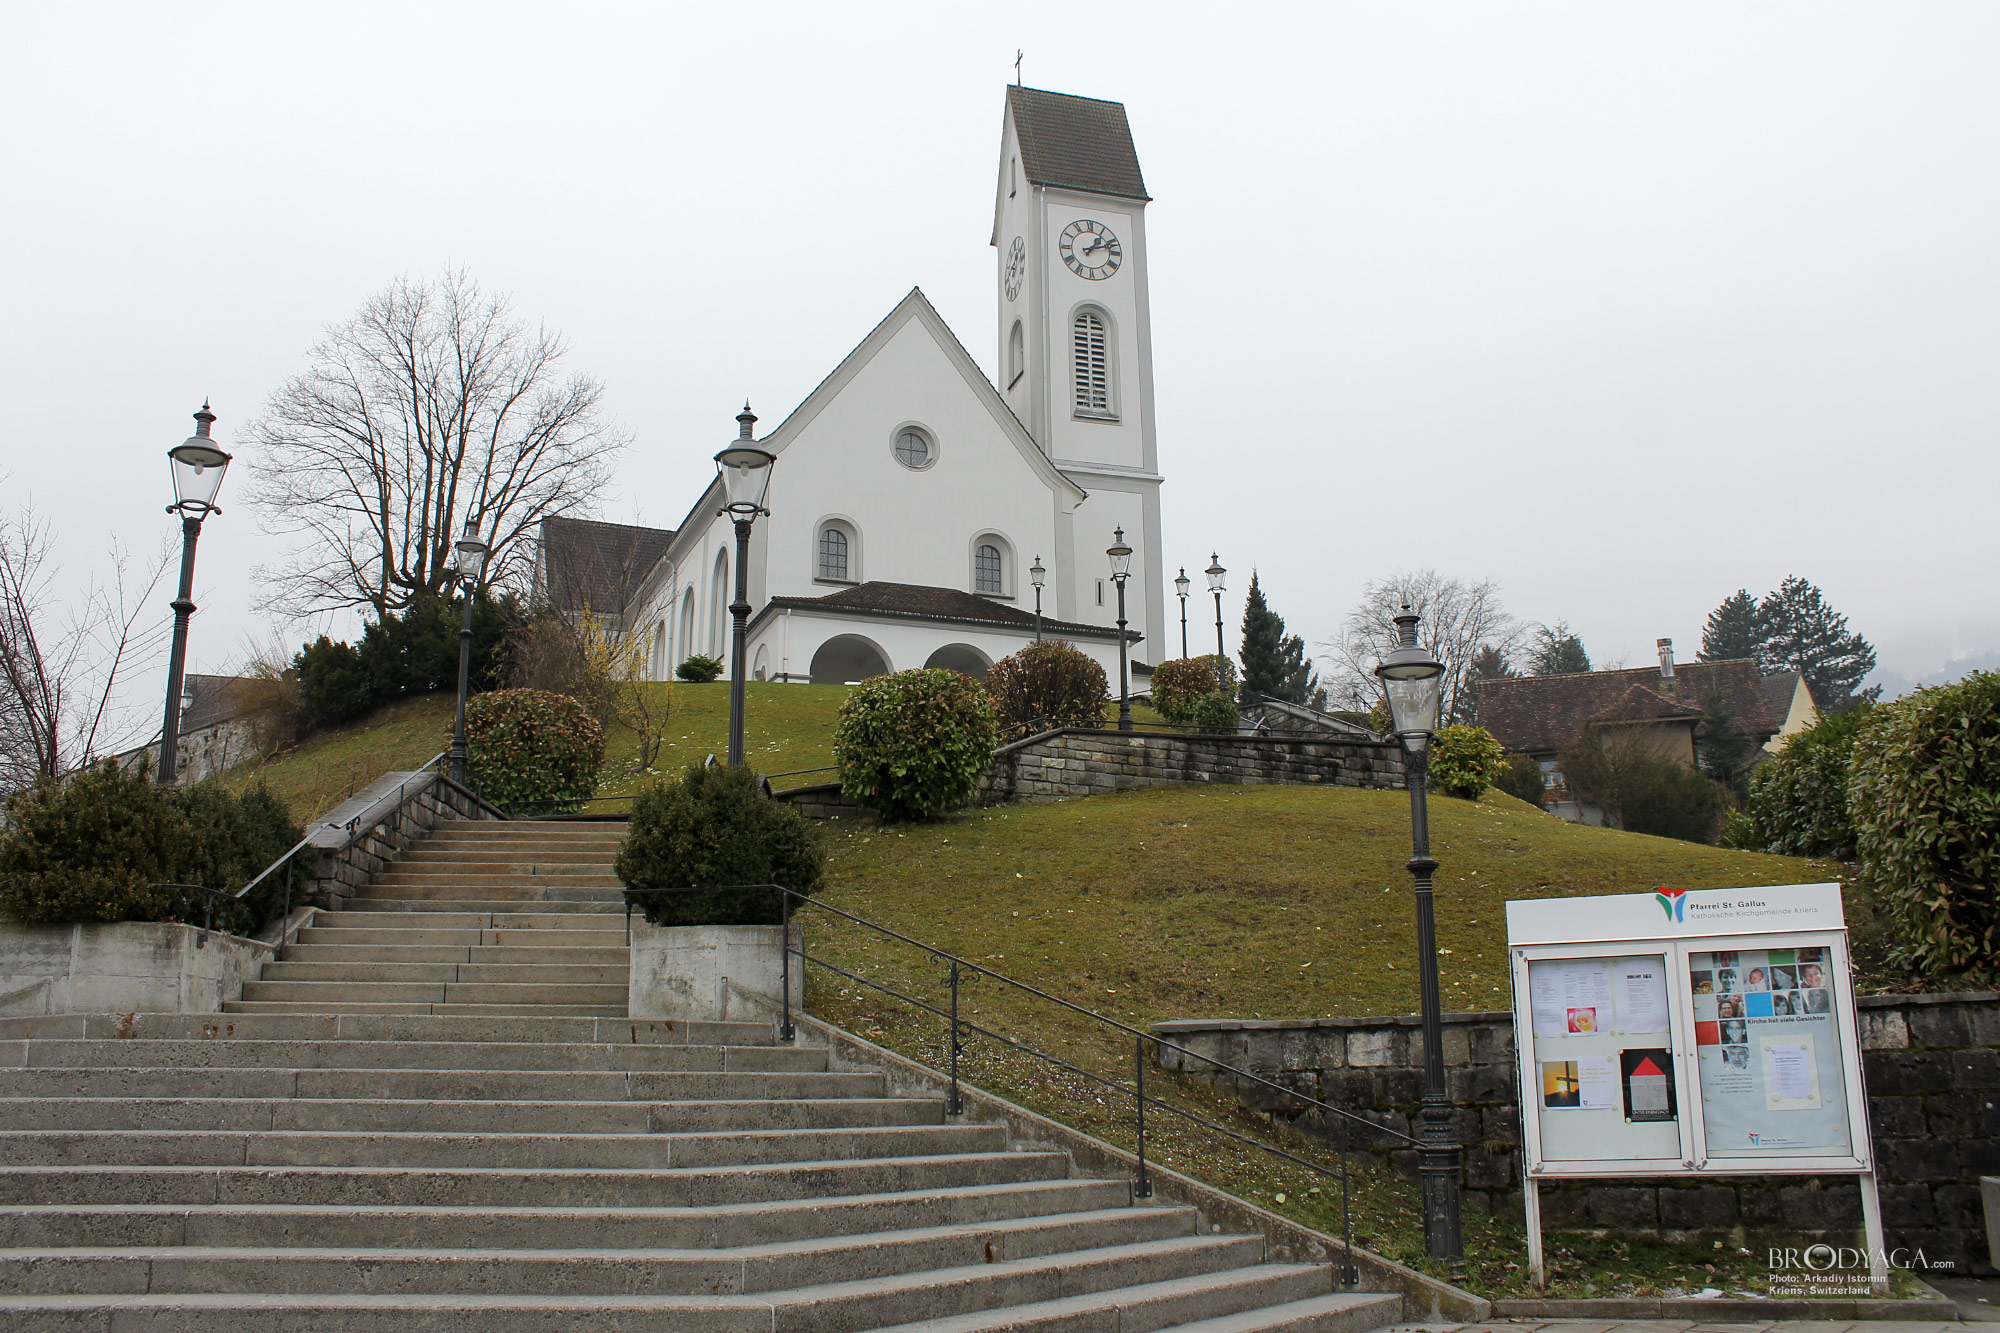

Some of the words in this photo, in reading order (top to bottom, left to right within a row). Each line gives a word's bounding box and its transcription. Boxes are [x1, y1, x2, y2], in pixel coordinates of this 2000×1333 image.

[1690, 902, 1719, 911] Pfarrei
[1722, 901, 1735, 909] St.
[1737, 900, 1766, 908] Gallus
[1691, 911, 1734, 920] Katholische
[1736, 908, 1792, 918] Kirchgemeinde
[1794, 906, 1818, 914] Kriens
